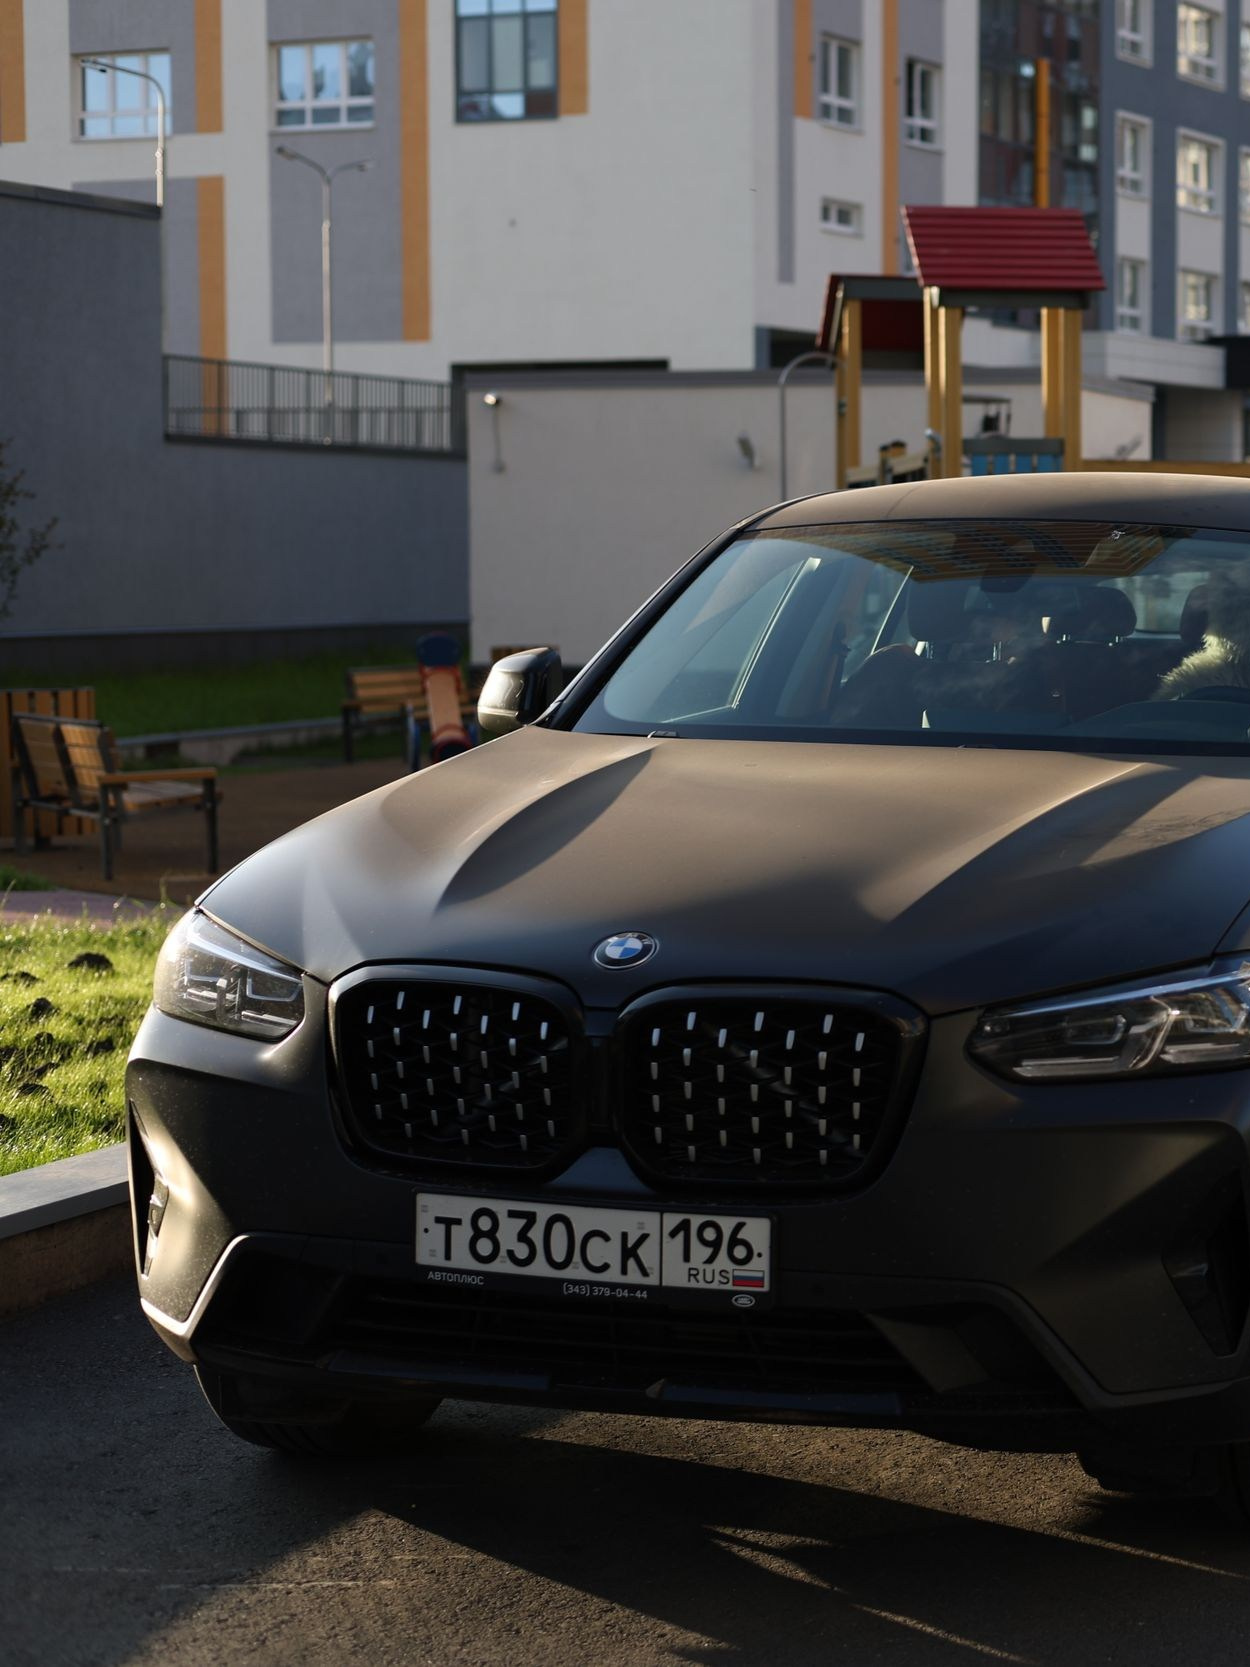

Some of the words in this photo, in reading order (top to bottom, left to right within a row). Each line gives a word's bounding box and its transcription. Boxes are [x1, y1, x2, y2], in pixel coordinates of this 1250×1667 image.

[668, 1218, 754, 1266] 196
[427, 1270, 484, 1285] АВТОПЛЮС
[687, 1267, 730, 1285] RUS
[562, 1282, 590, 1296] (343)
[591, 1285, 648, 1299] 379-04-44
